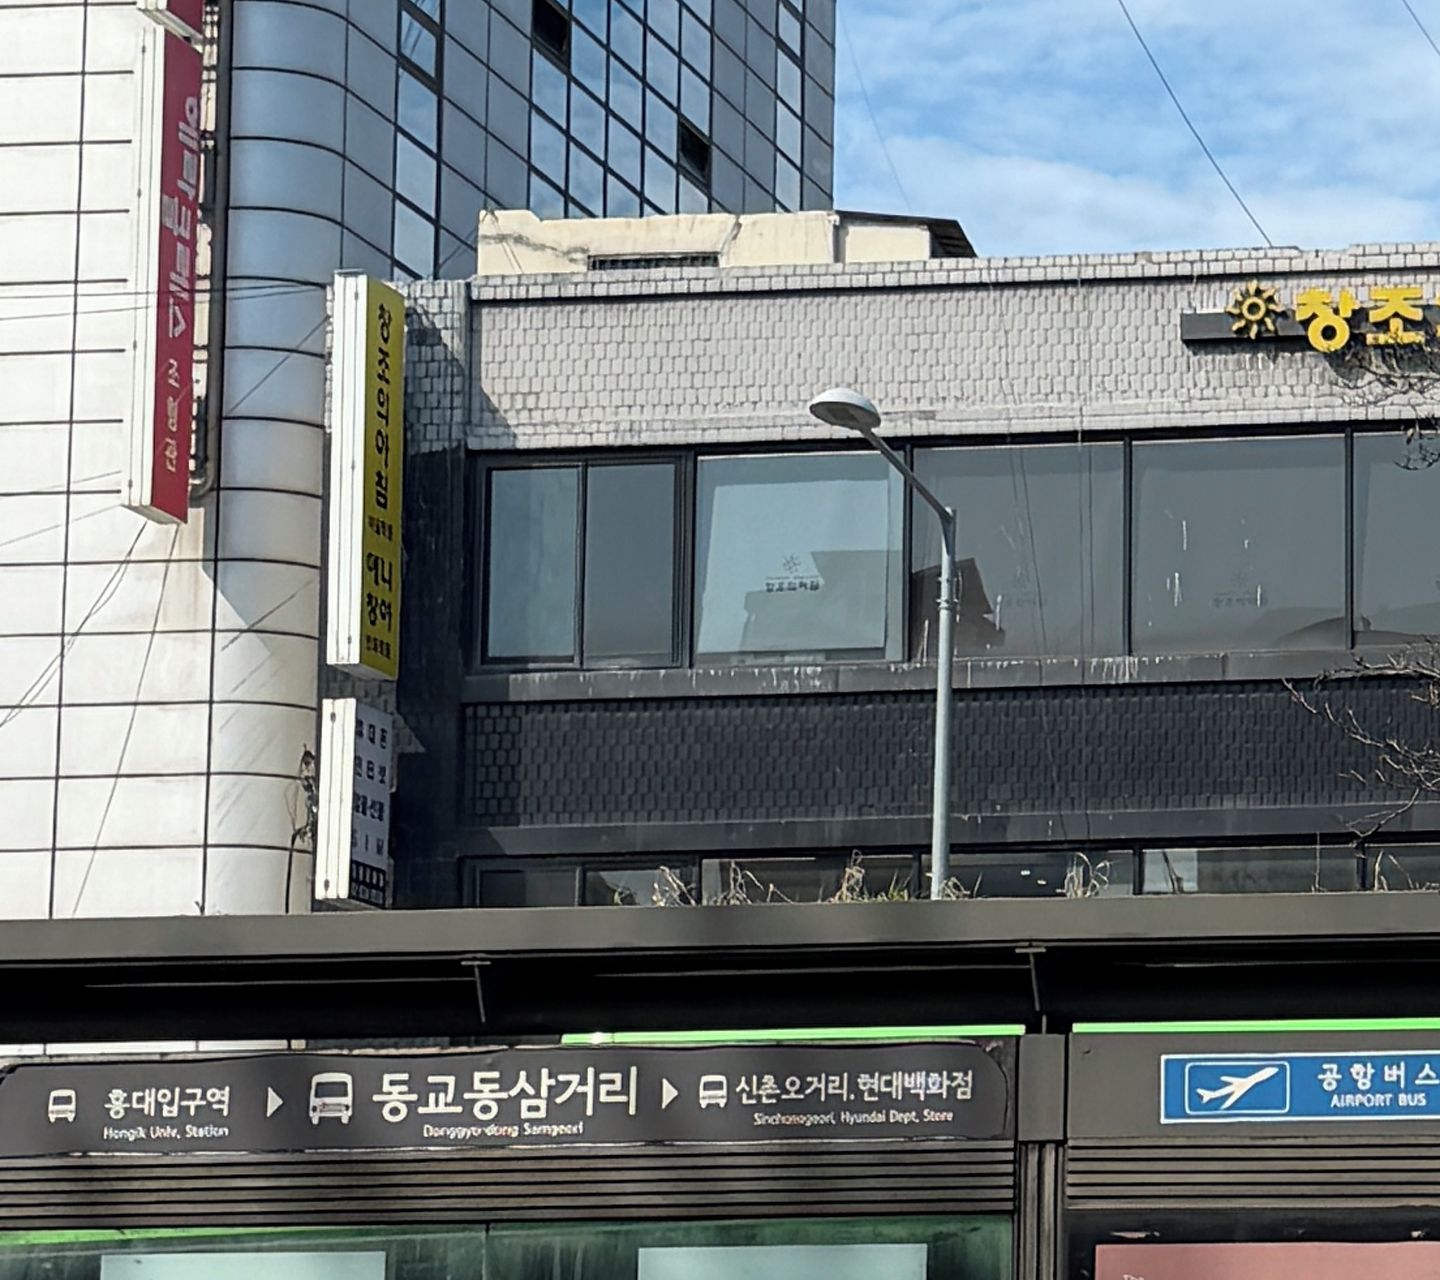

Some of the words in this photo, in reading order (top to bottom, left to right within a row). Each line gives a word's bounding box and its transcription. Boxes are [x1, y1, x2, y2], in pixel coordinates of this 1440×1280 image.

[374, 302, 393, 510] 창조의아침
[1317, 1060, 1440, 1092] 공항버스
[104, 1085, 231, 1122] 홍대입구역
[371, 1064, 639, 1124] 동교동삼거리
[1330, 1093, 1392, 1109] AIRPORT
[1398, 1092, 1428, 1108] BUS
[523, 1121, 584, 1137] Samgeori
[840, 1110, 886, 1125] Hyundai
[922, 1108, 954, 1122] Store
[103, 1125, 147, 1141] Hongik
[185, 1123, 229, 1138] Station
